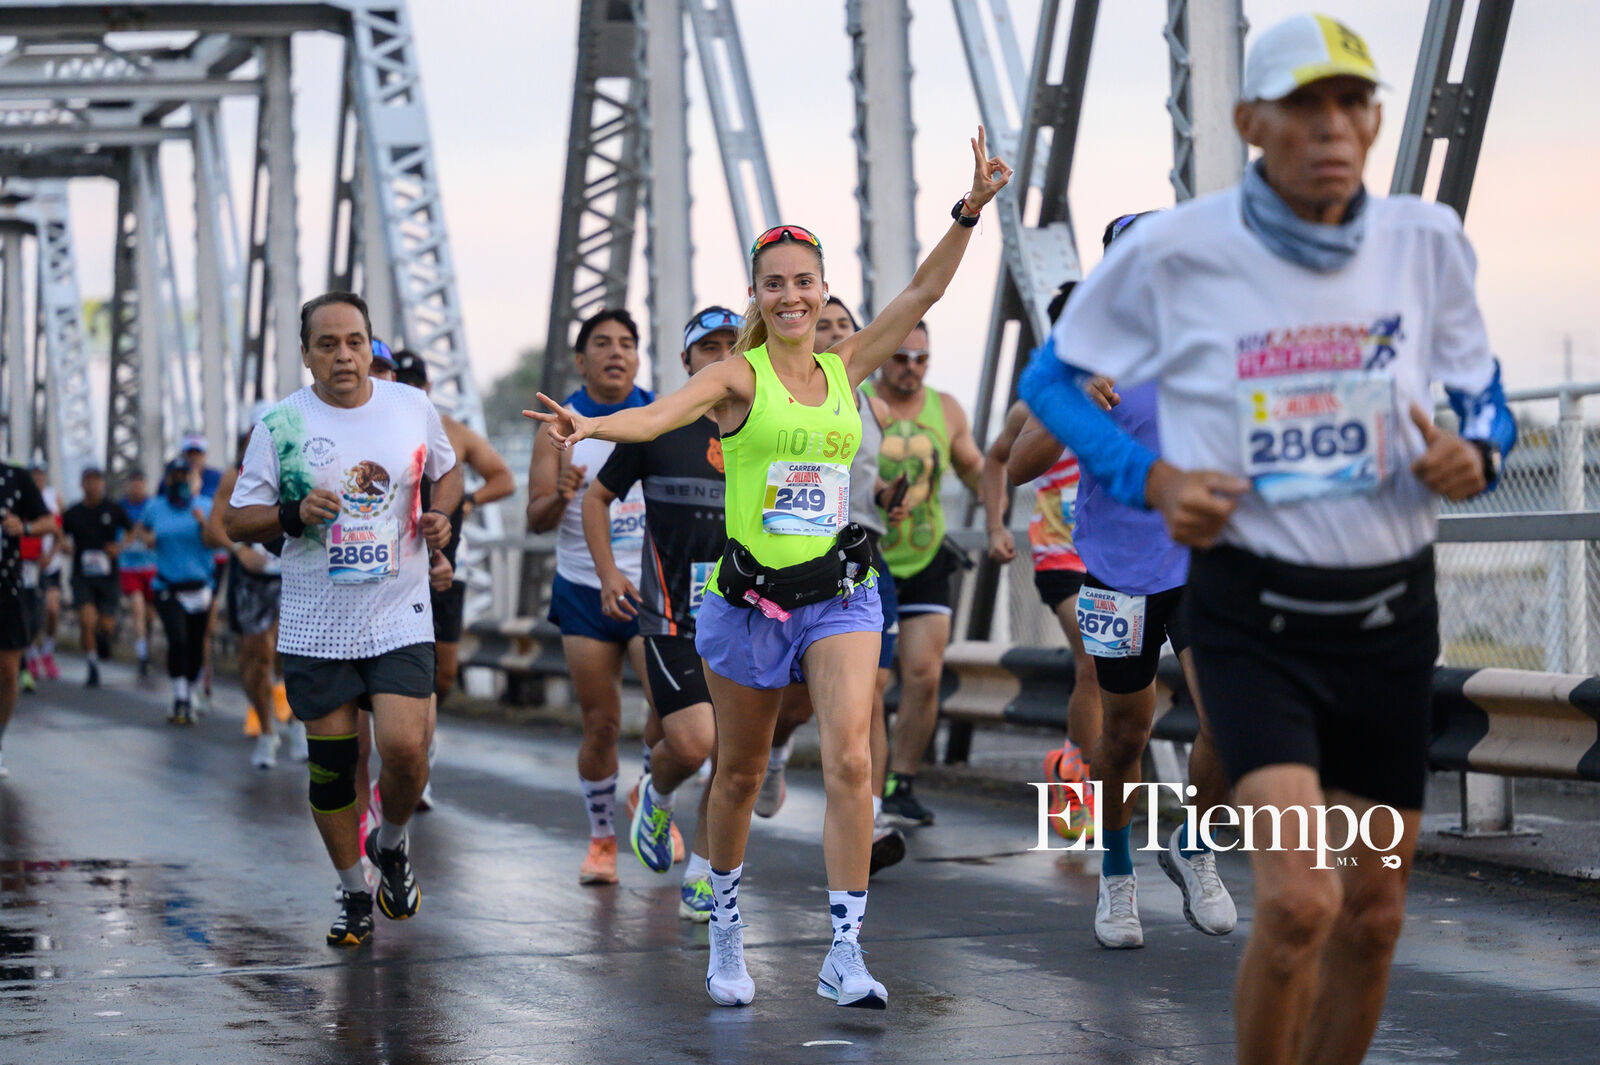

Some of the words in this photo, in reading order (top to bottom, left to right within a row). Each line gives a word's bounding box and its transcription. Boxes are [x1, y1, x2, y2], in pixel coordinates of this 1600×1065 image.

[1249, 419, 1368, 465] 2869
[775, 488, 826, 512] 249
[329, 544, 389, 565] 2866
[1085, 591, 1116, 601] CARRERA
[1077, 610, 1129, 638] 2670
